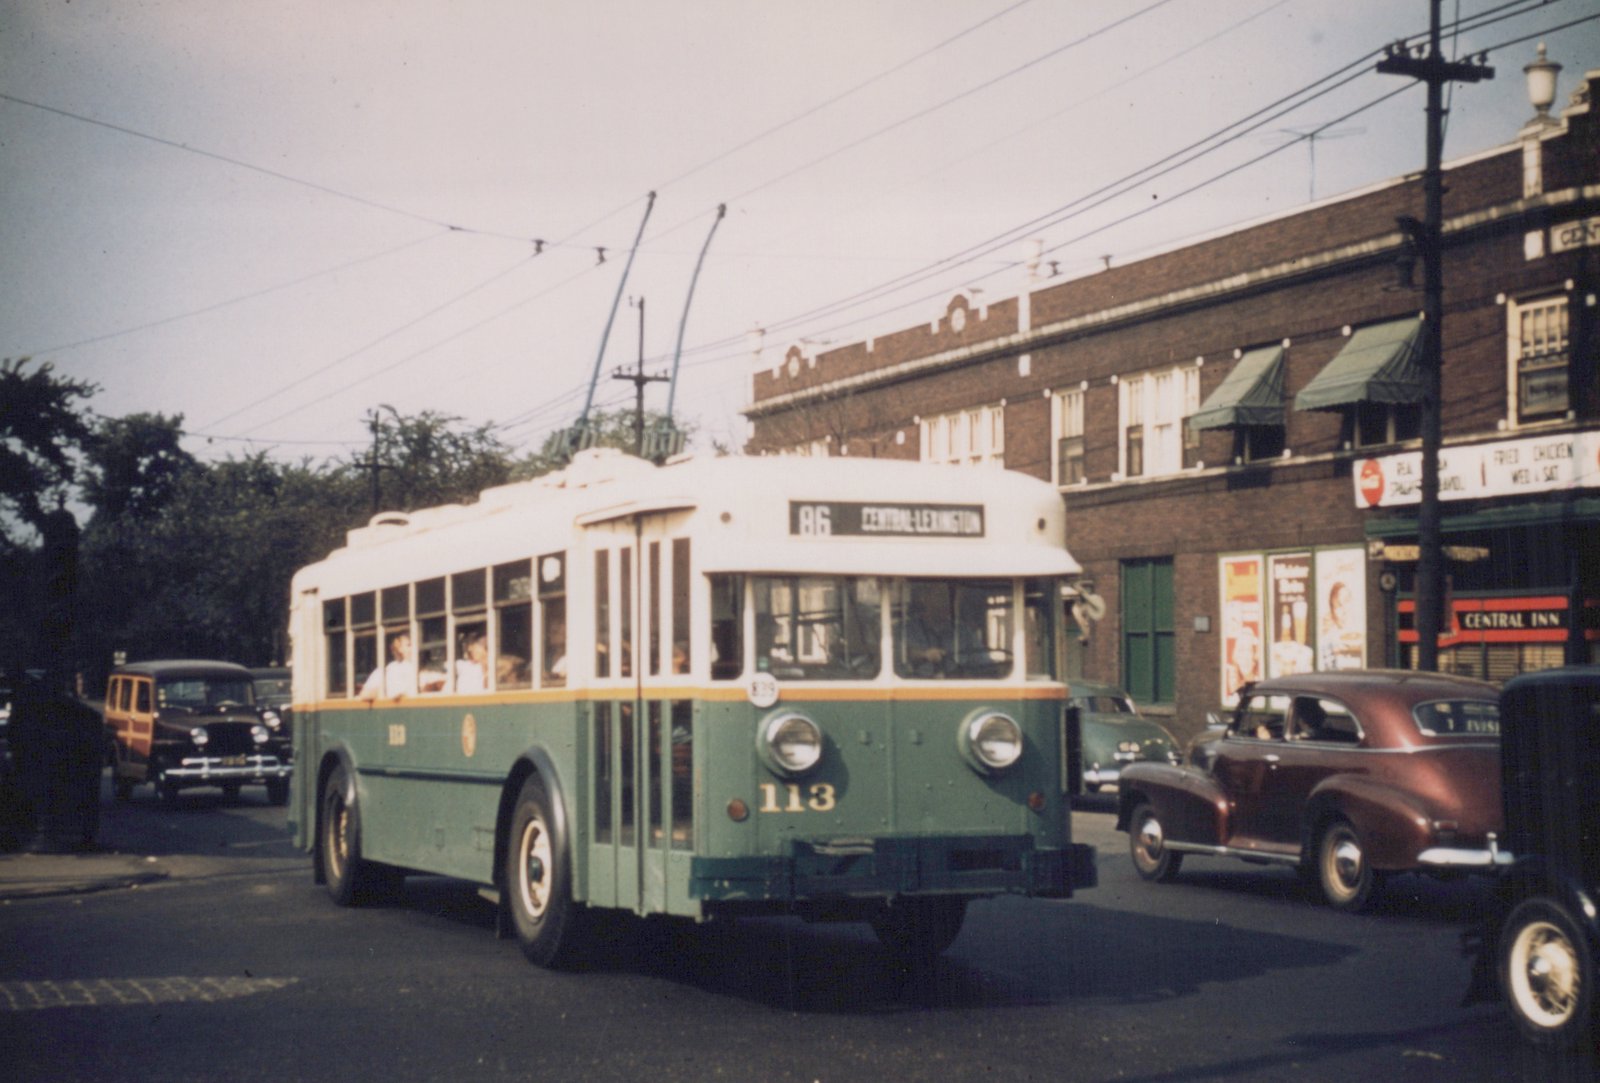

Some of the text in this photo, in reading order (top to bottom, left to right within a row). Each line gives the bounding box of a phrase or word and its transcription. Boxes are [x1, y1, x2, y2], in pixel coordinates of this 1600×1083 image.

[1494, 442, 1575, 465] FRIED CHICKEN
[1543, 465, 1559, 482] SAT
[799, 505, 831, 535] 86
[1465, 612, 1560, 628] CENTRAL INN
[760, 783, 835, 813] 113
